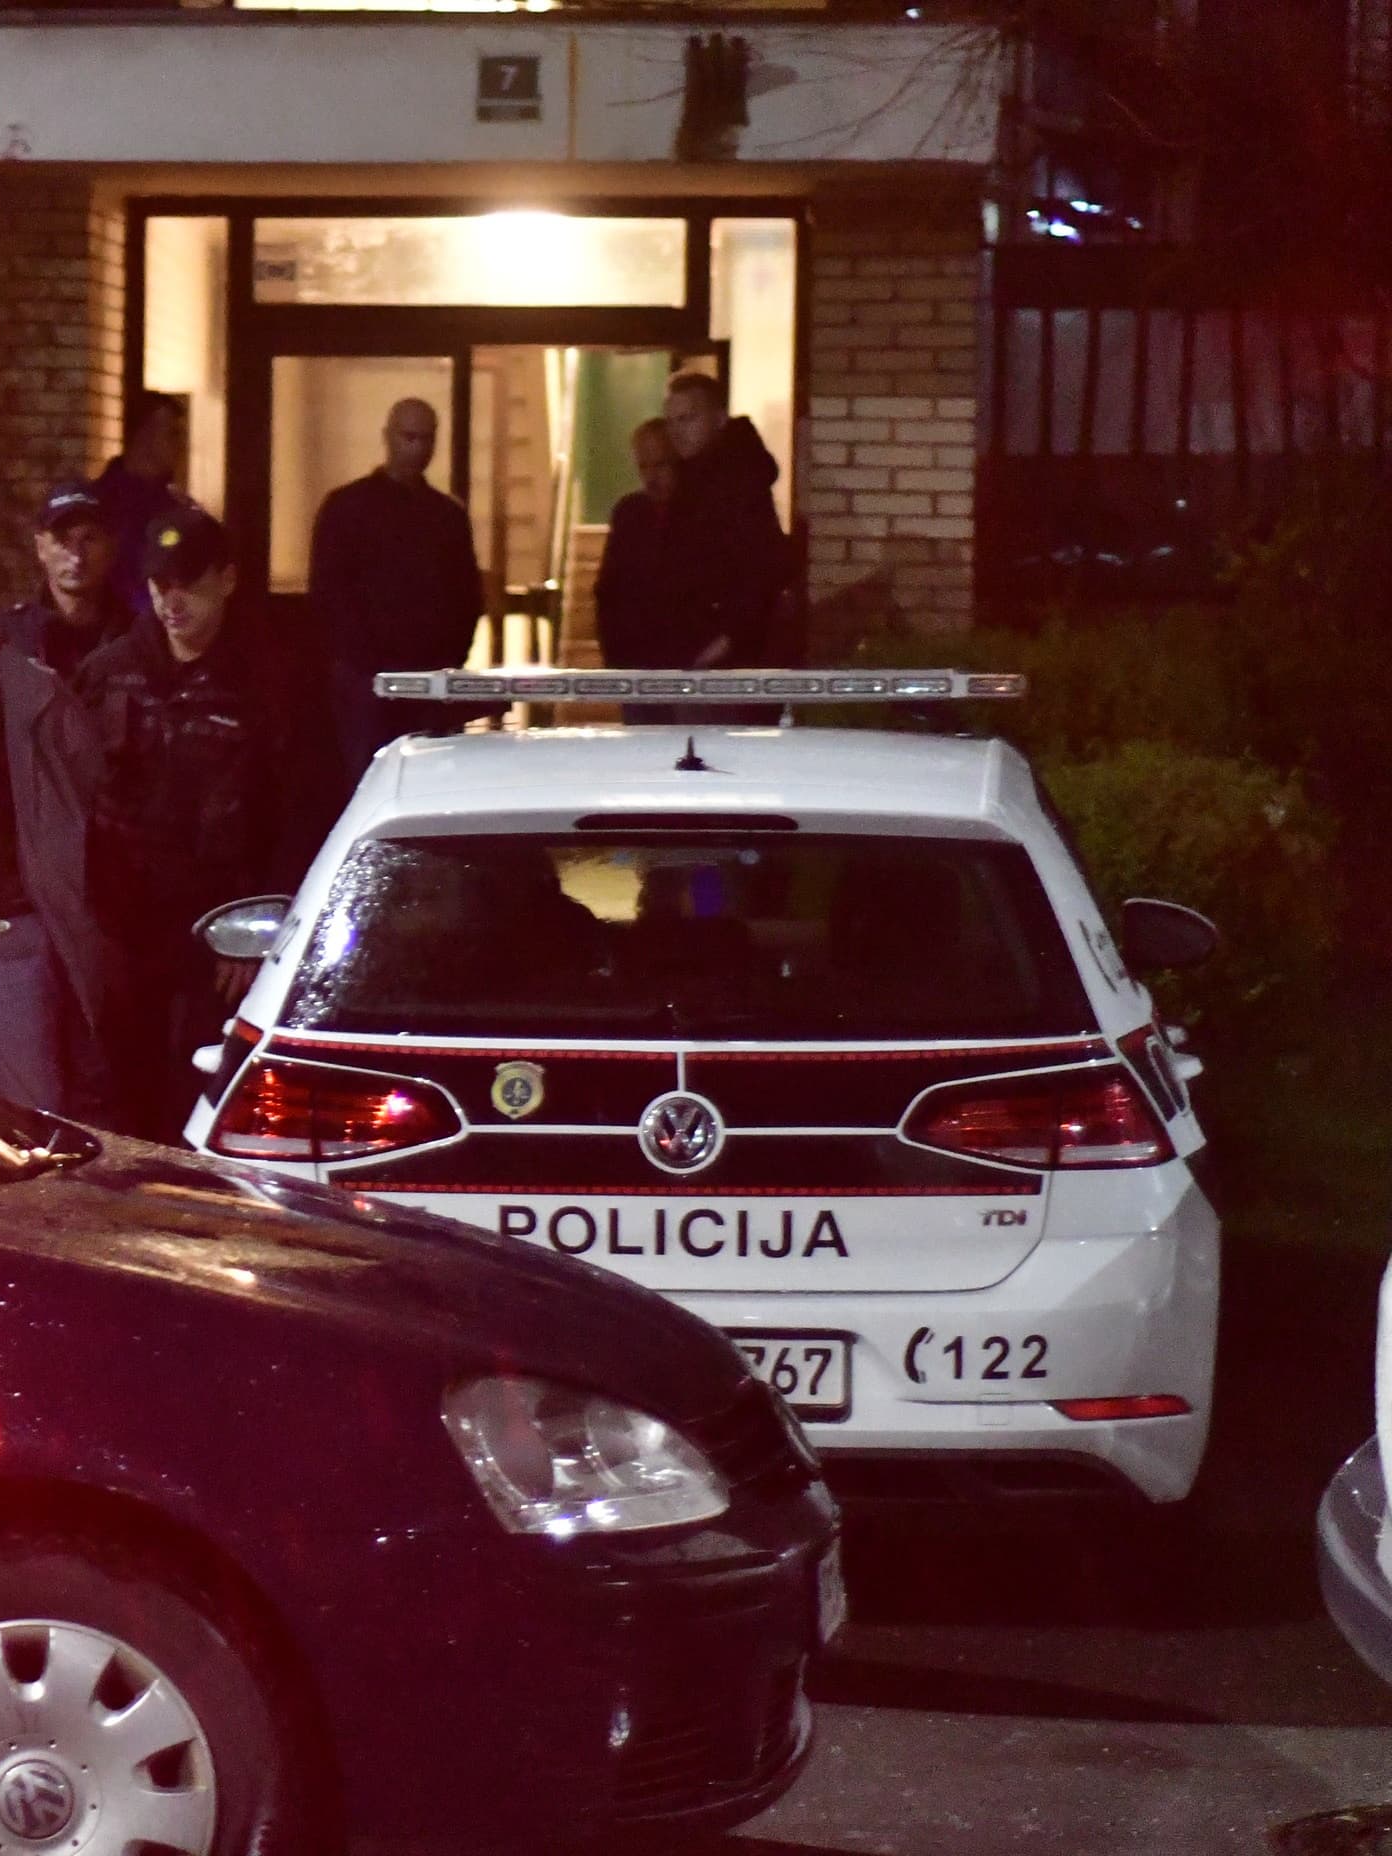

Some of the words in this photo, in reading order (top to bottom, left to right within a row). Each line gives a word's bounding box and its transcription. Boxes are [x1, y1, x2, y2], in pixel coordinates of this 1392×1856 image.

[500, 65, 520, 91] 7
[499, 1205, 849, 1259] POLICIJA
[943, 1334, 1049, 1380] 122
